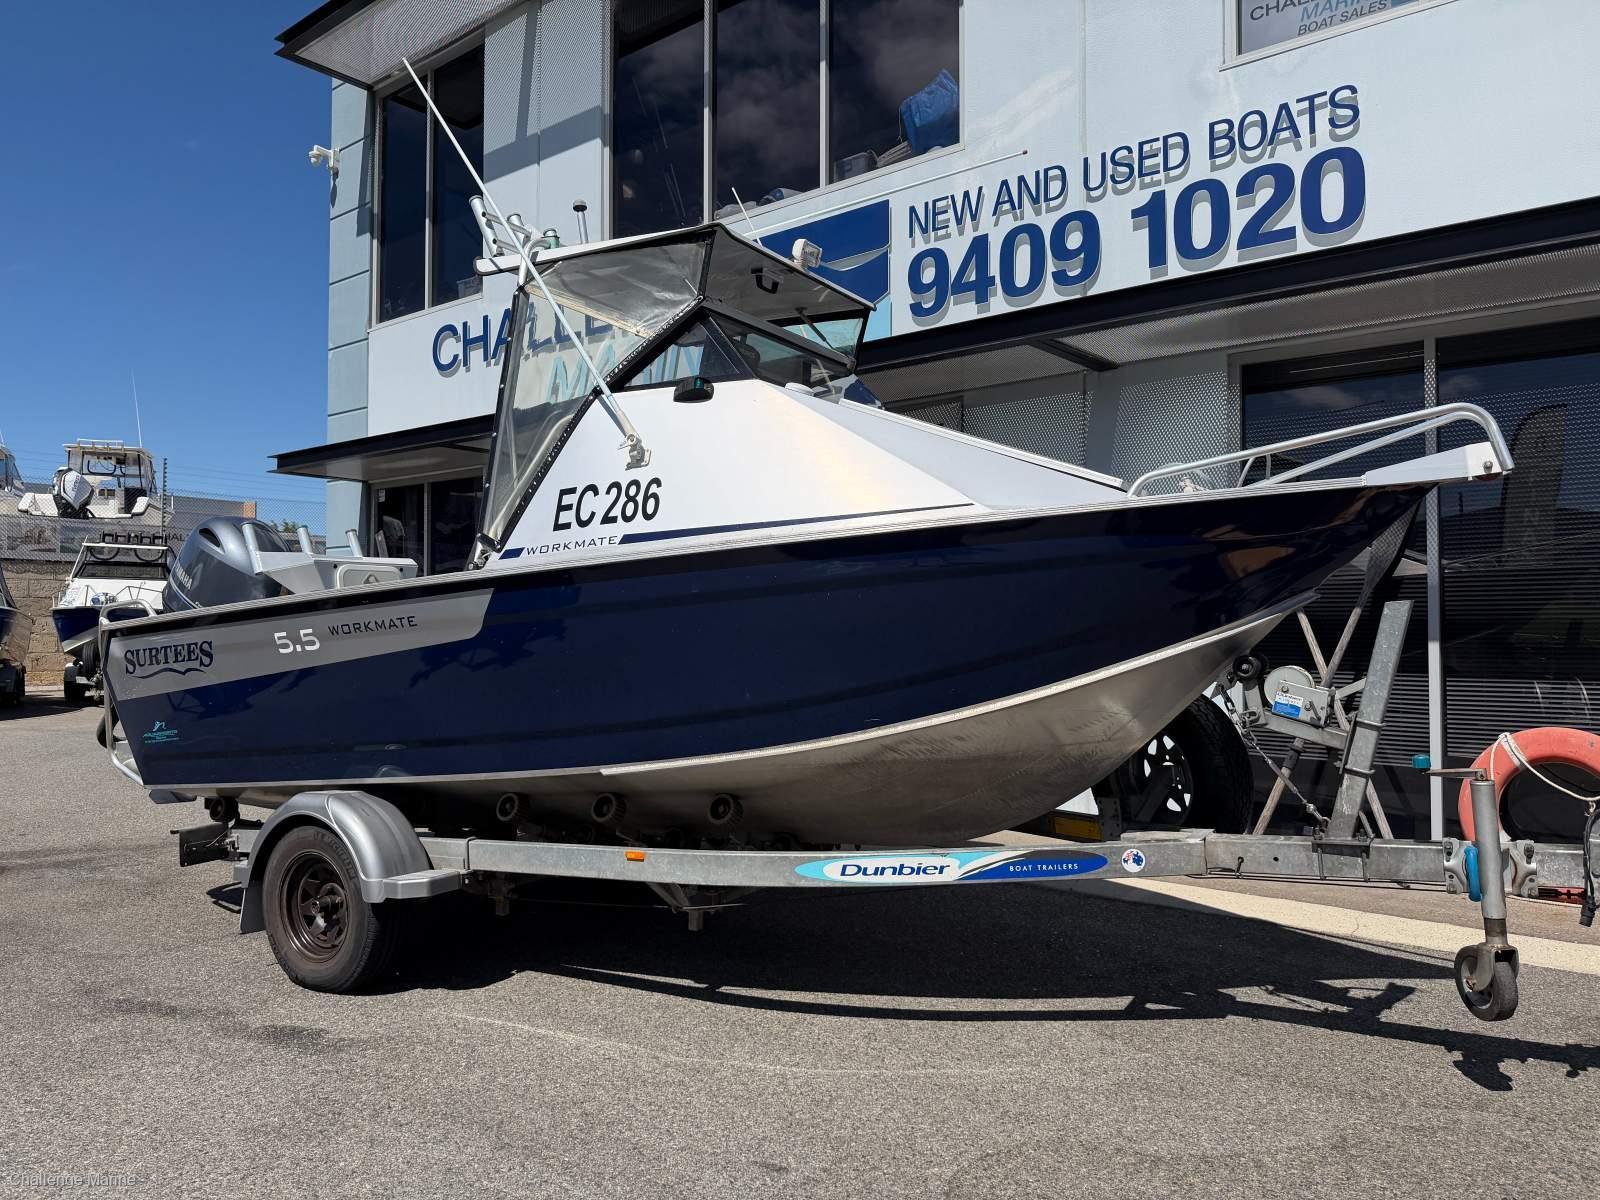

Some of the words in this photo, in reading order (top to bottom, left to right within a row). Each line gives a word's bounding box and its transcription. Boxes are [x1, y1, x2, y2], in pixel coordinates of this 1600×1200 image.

[1298, 14, 1338, 36] BOAT
[1339, 0, 1388, 23] SALES
[908, 186, 984, 240] NEW
[992, 165, 1068, 218] AND
[1083, 132, 1190, 193] USED
[1209, 85, 1361, 162] BOATS
[908, 210, 1101, 318] 9409
[1131, 146, 1366, 269] 1020
[526, 535, 619, 556] WORKMATE
[273, 628, 321, 654] 5.5
[328, 615, 418, 637] WORKMATE
[124, 640, 214, 675] SURTEES
[840, 862, 951, 877] Dunbier
[1036, 863, 1079, 872] TRAILERS
